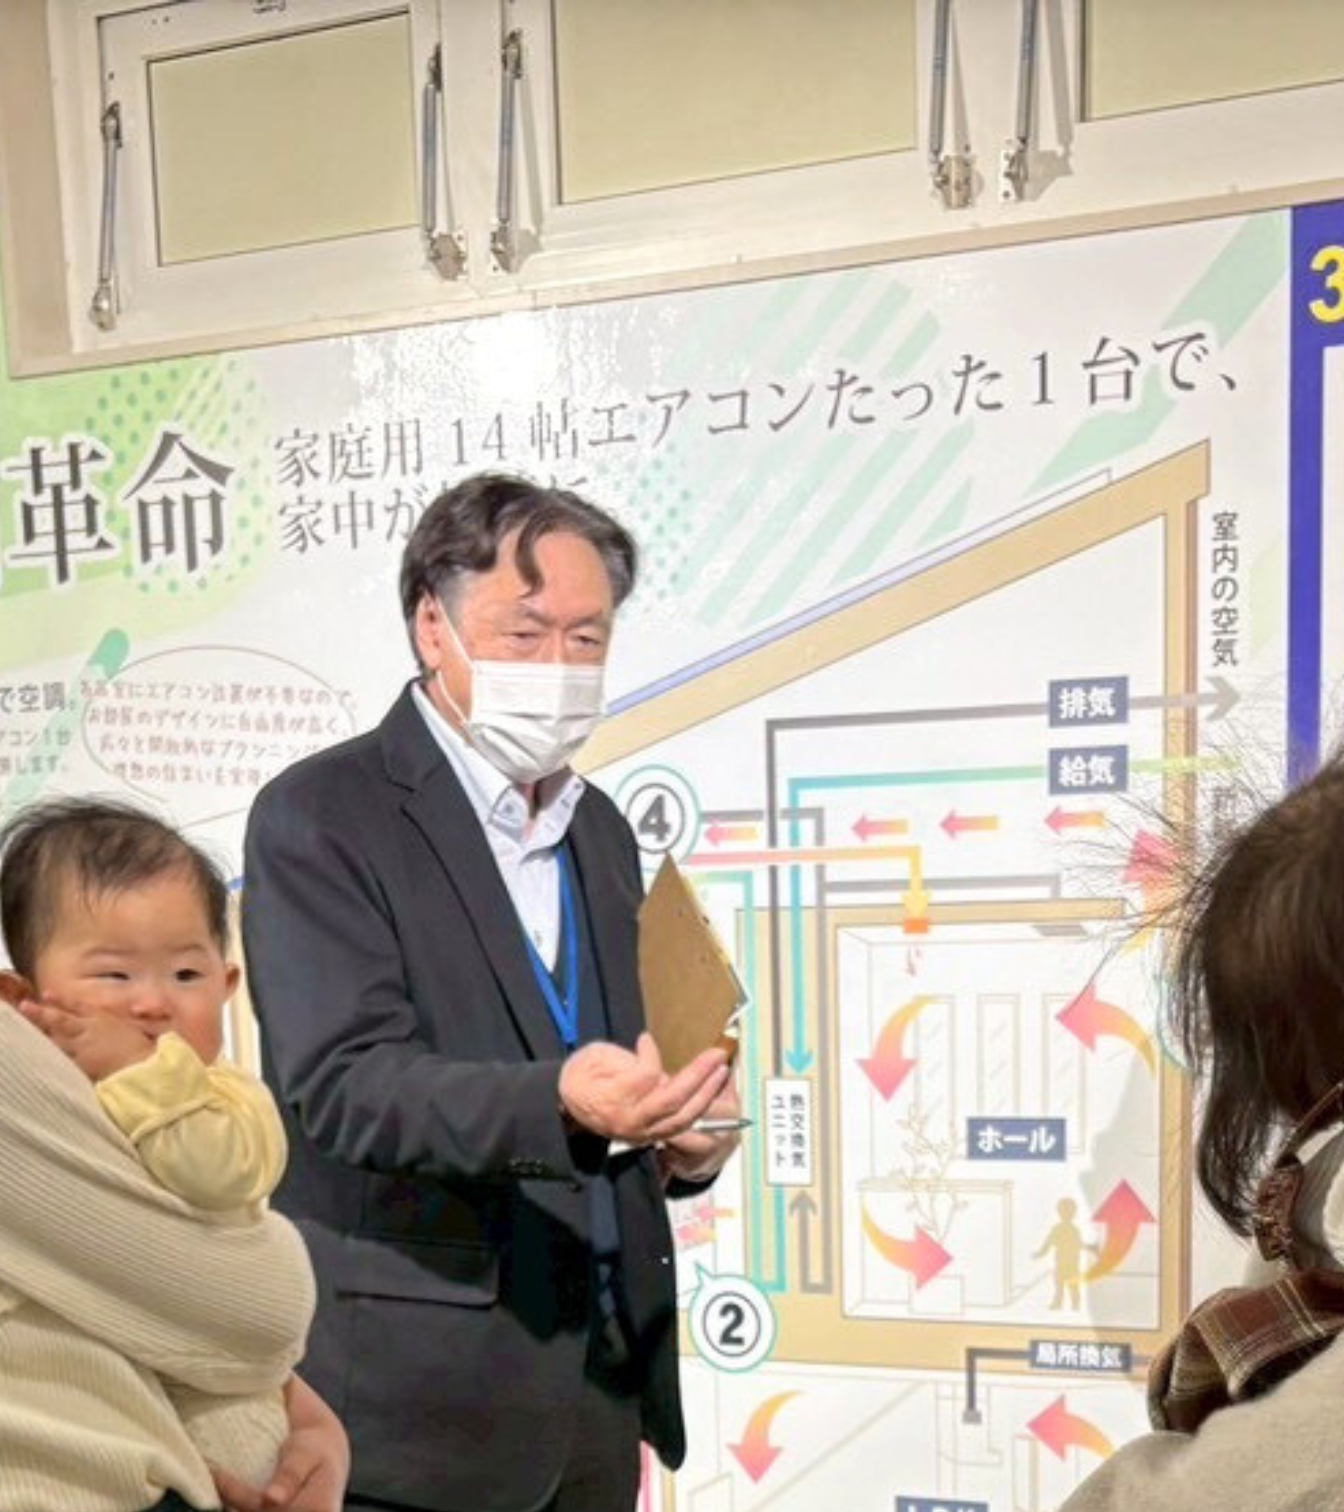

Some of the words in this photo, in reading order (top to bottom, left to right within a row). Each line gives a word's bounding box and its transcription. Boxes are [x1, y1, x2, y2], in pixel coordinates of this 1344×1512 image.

[274, 330, 1239, 489] 家庭用14帖エアコンたった1台で、
[1211, 511, 1239, 667] 室内の空気
[1058, 687, 1116, 719] 排気
[1058, 755, 1115, 787] 給気
[976, 1122, 1055, 1155] ホール
